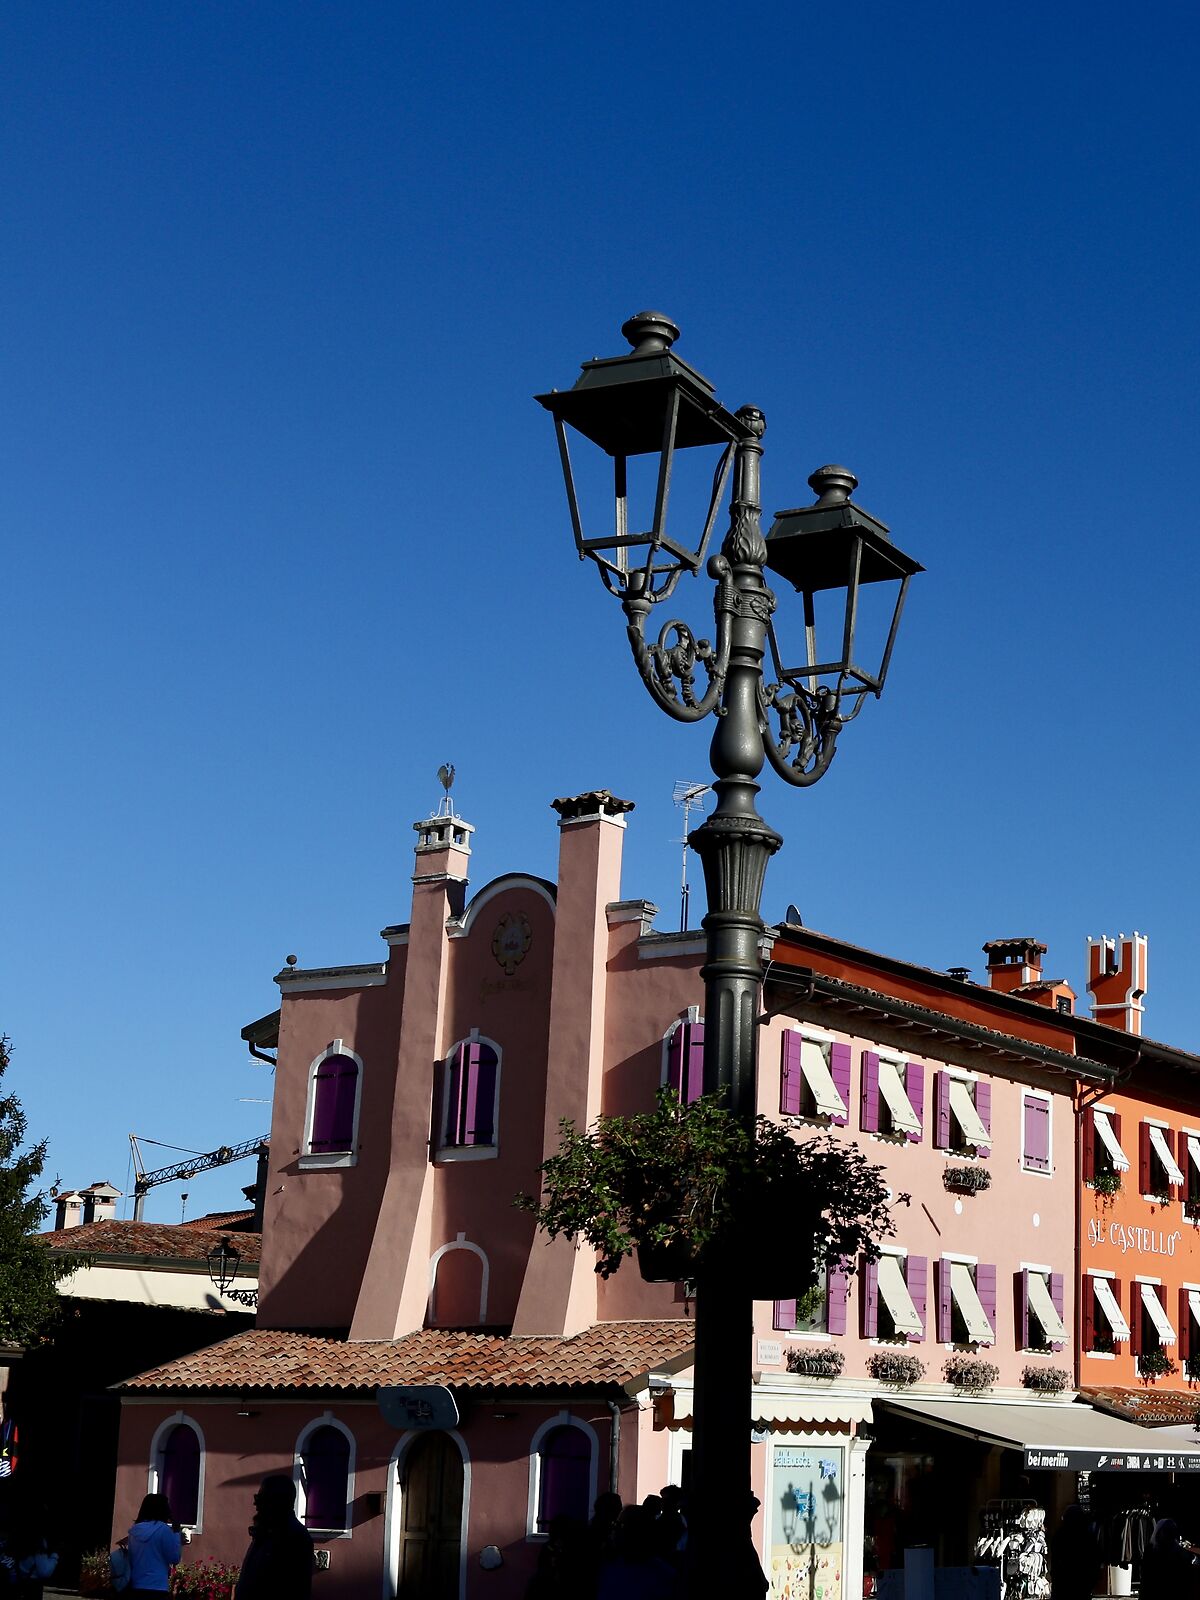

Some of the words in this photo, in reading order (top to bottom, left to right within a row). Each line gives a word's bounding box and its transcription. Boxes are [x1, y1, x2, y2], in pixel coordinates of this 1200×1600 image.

[1088, 1218, 1105, 1247] AL
[1110, 1222, 1181, 1256] CASTELLO
[1028, 1451, 1041, 1466] bei
[1041, 1452, 1069, 1467] merilin
